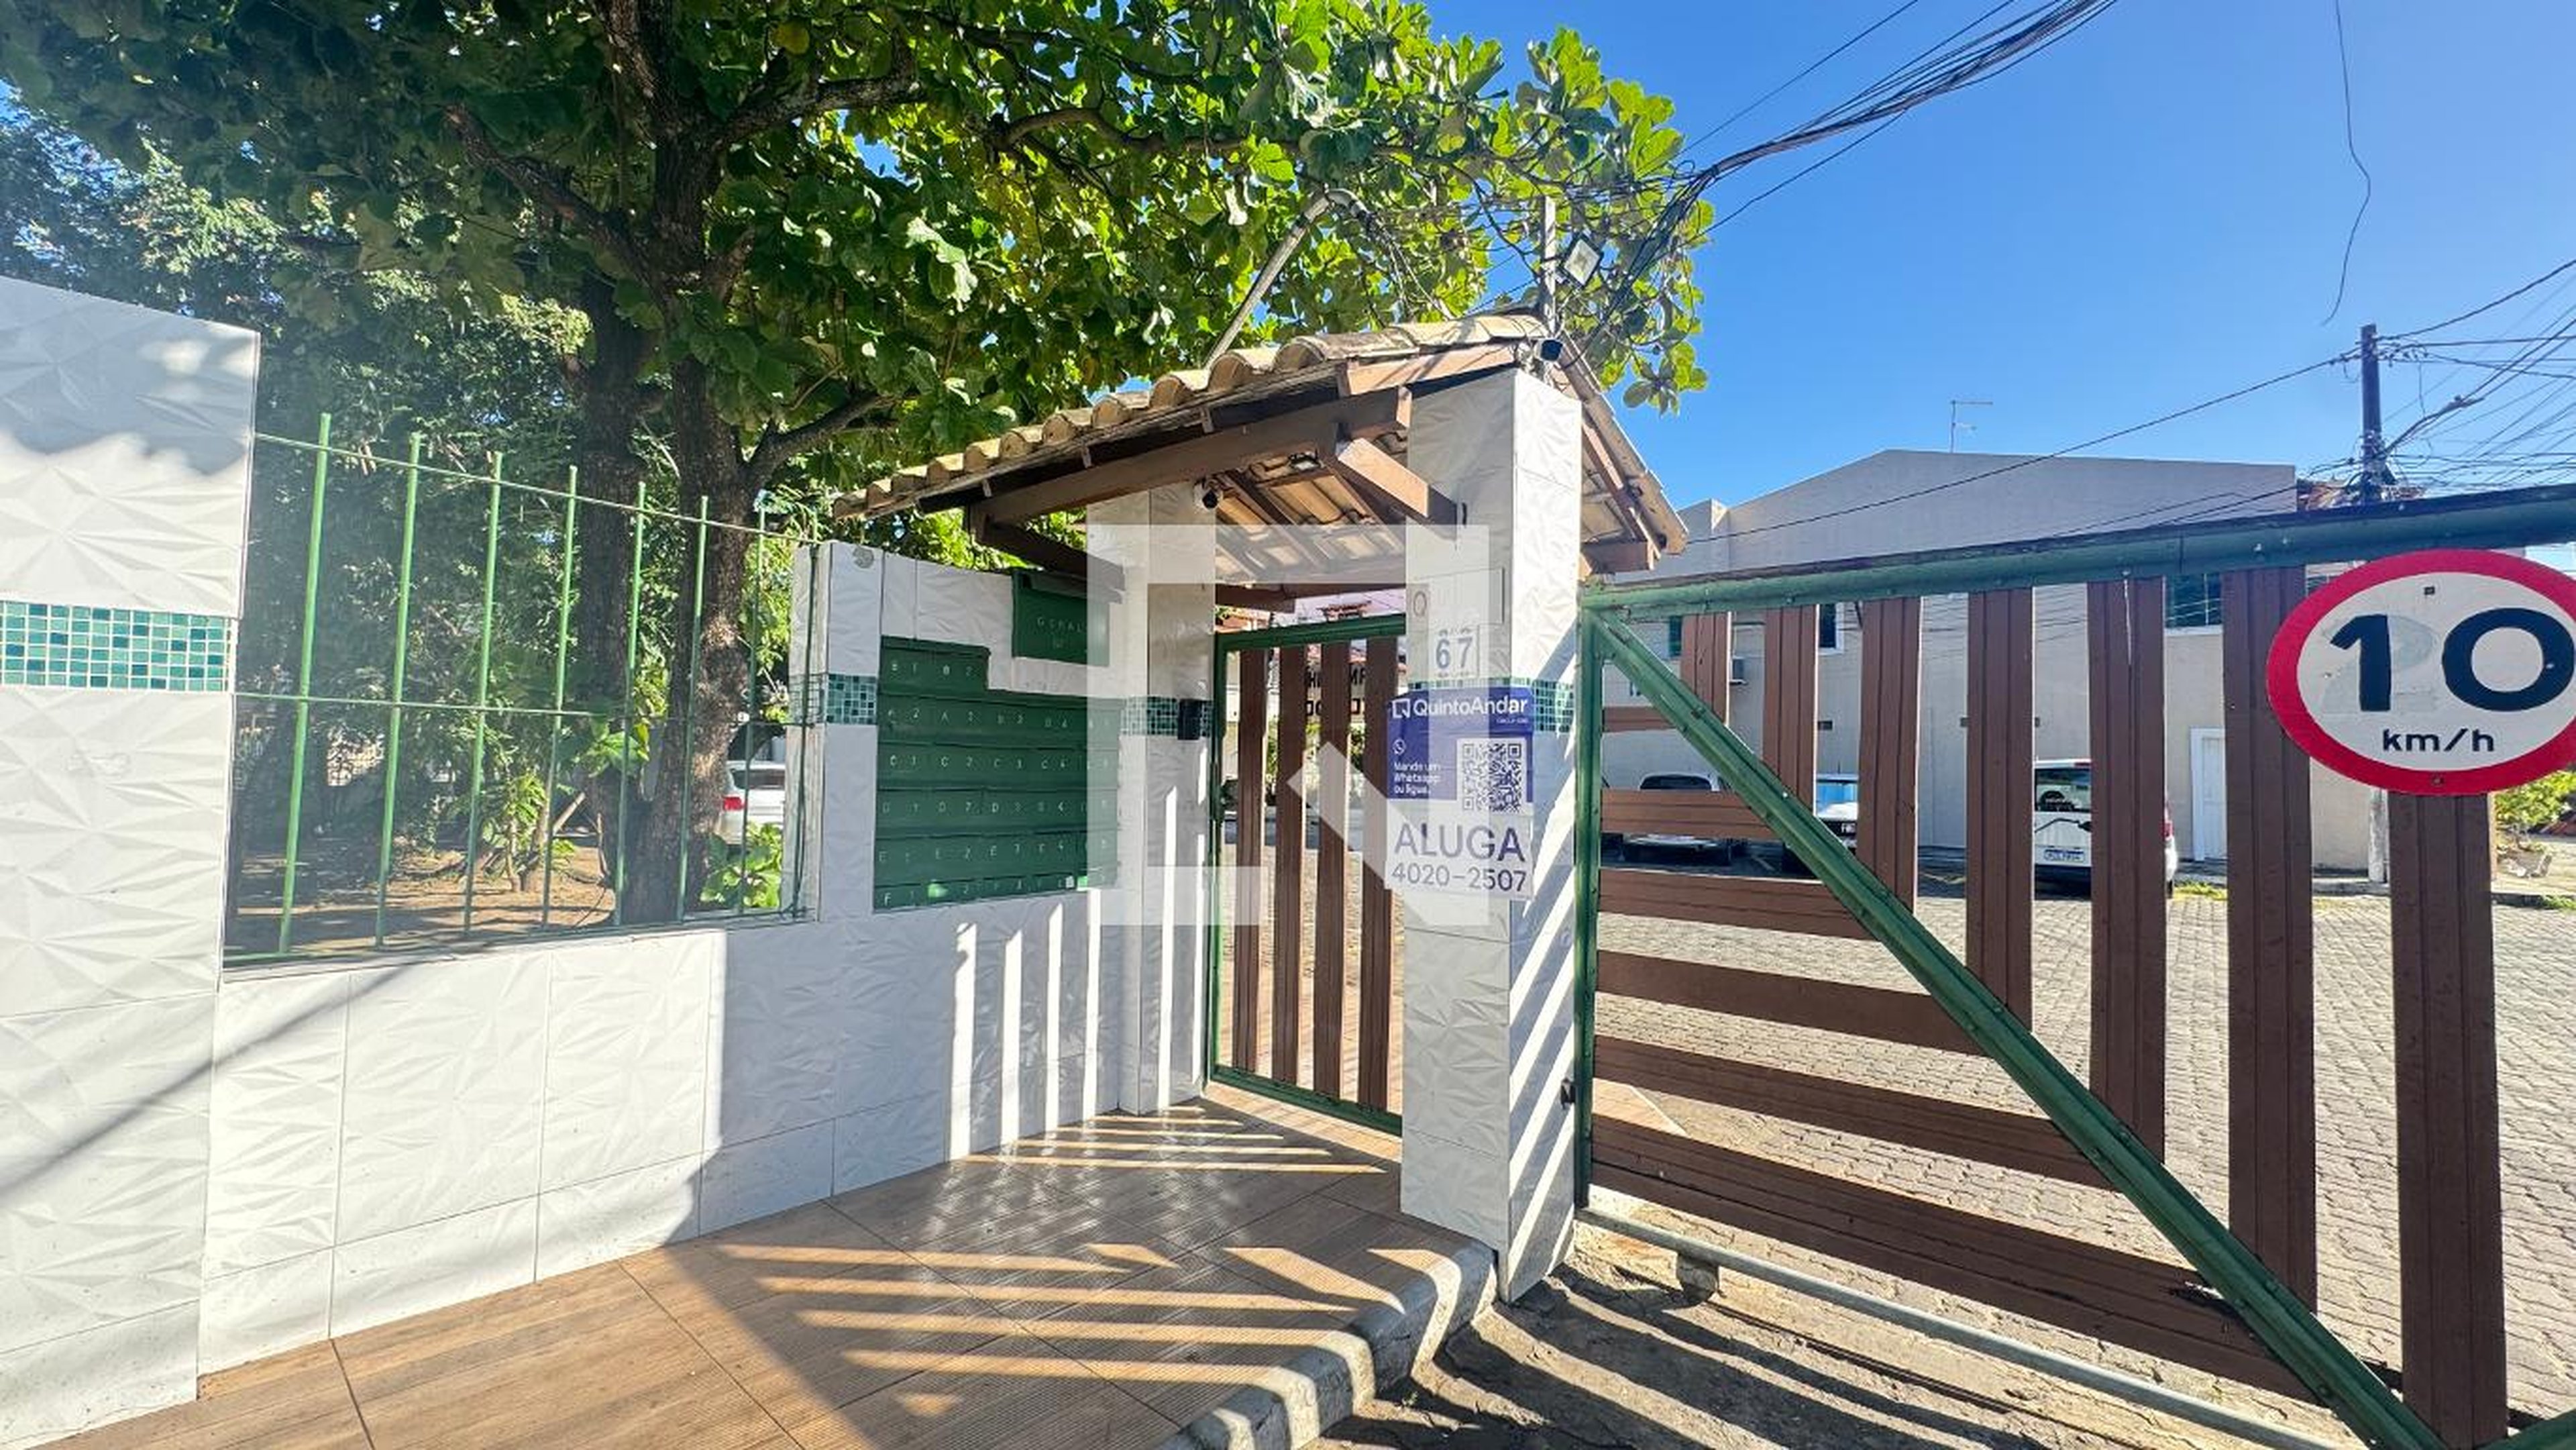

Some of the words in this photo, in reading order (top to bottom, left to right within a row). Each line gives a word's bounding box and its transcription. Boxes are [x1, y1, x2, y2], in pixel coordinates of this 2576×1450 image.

[1436, 637, 1472, 670] 67
[2330, 607, 2575, 713] 10
[1413, 695, 1528, 716] QuintoAndar
[2383, 728, 2495, 752] km/h
[1394, 821, 1525, 862] ALUGA
[1391, 862, 1527, 892] 4020-2507
